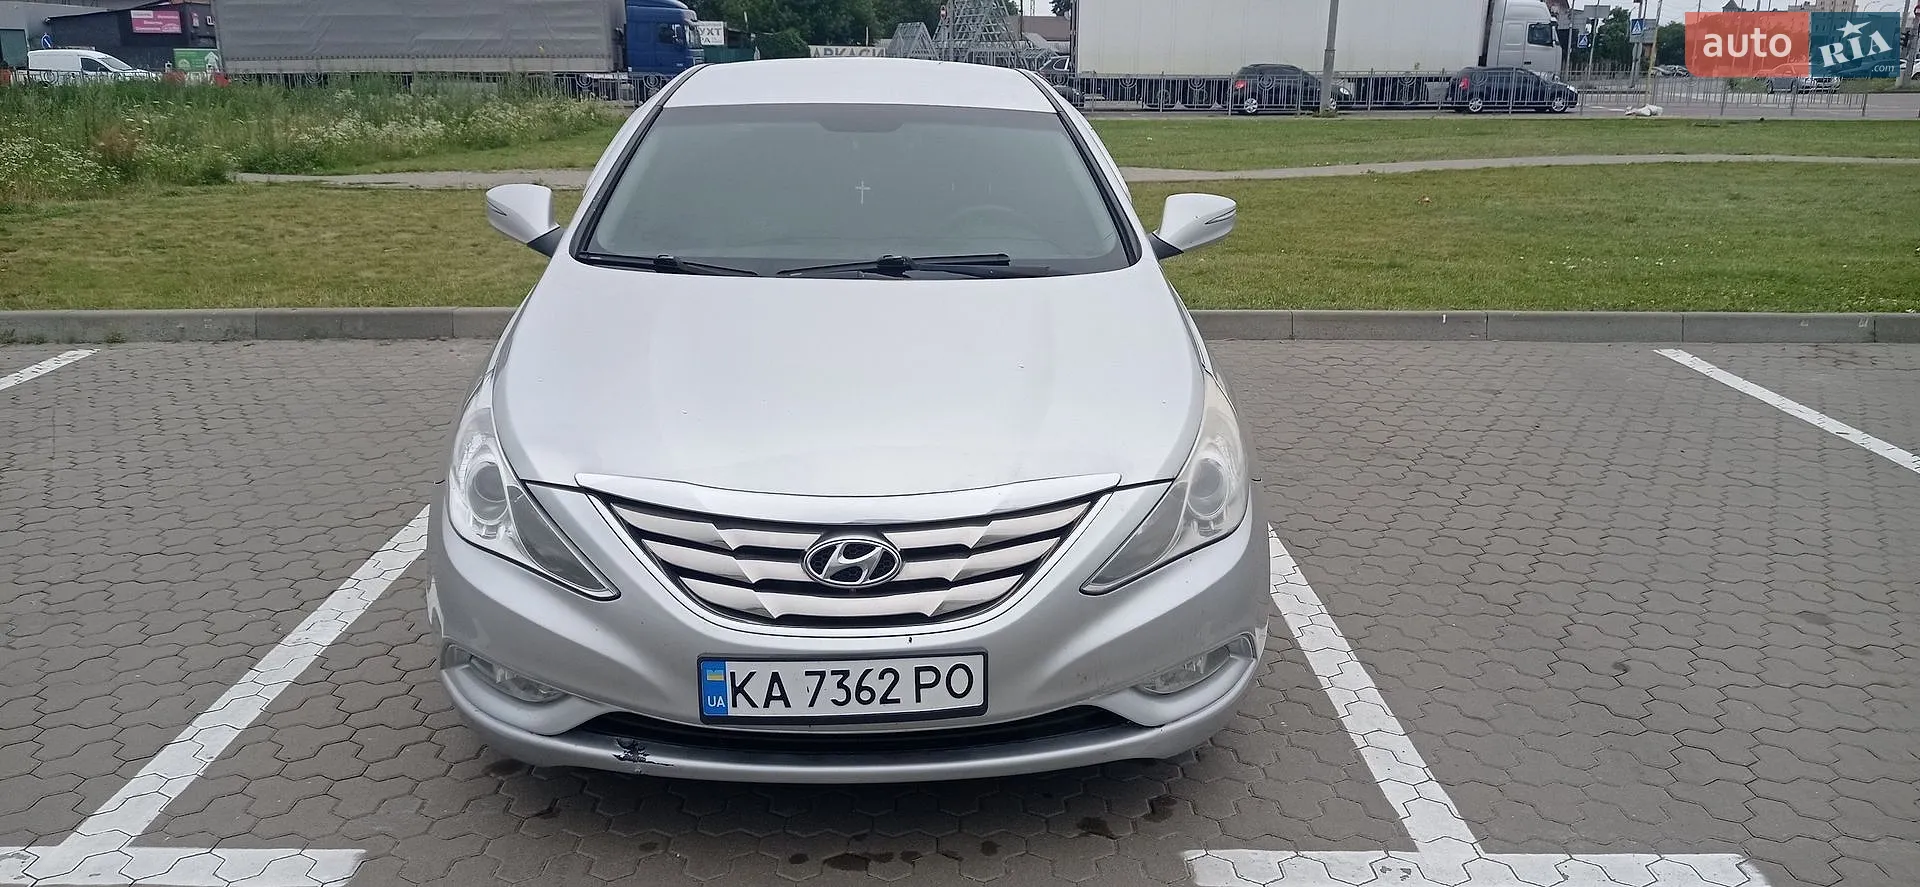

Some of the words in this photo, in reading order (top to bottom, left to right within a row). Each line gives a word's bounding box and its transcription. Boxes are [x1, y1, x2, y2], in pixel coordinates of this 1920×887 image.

[729, 670, 791, 708] KA
[804, 667, 901, 707] 7362
[914, 662, 975, 704] PO
[706, 695, 726, 708] UA
